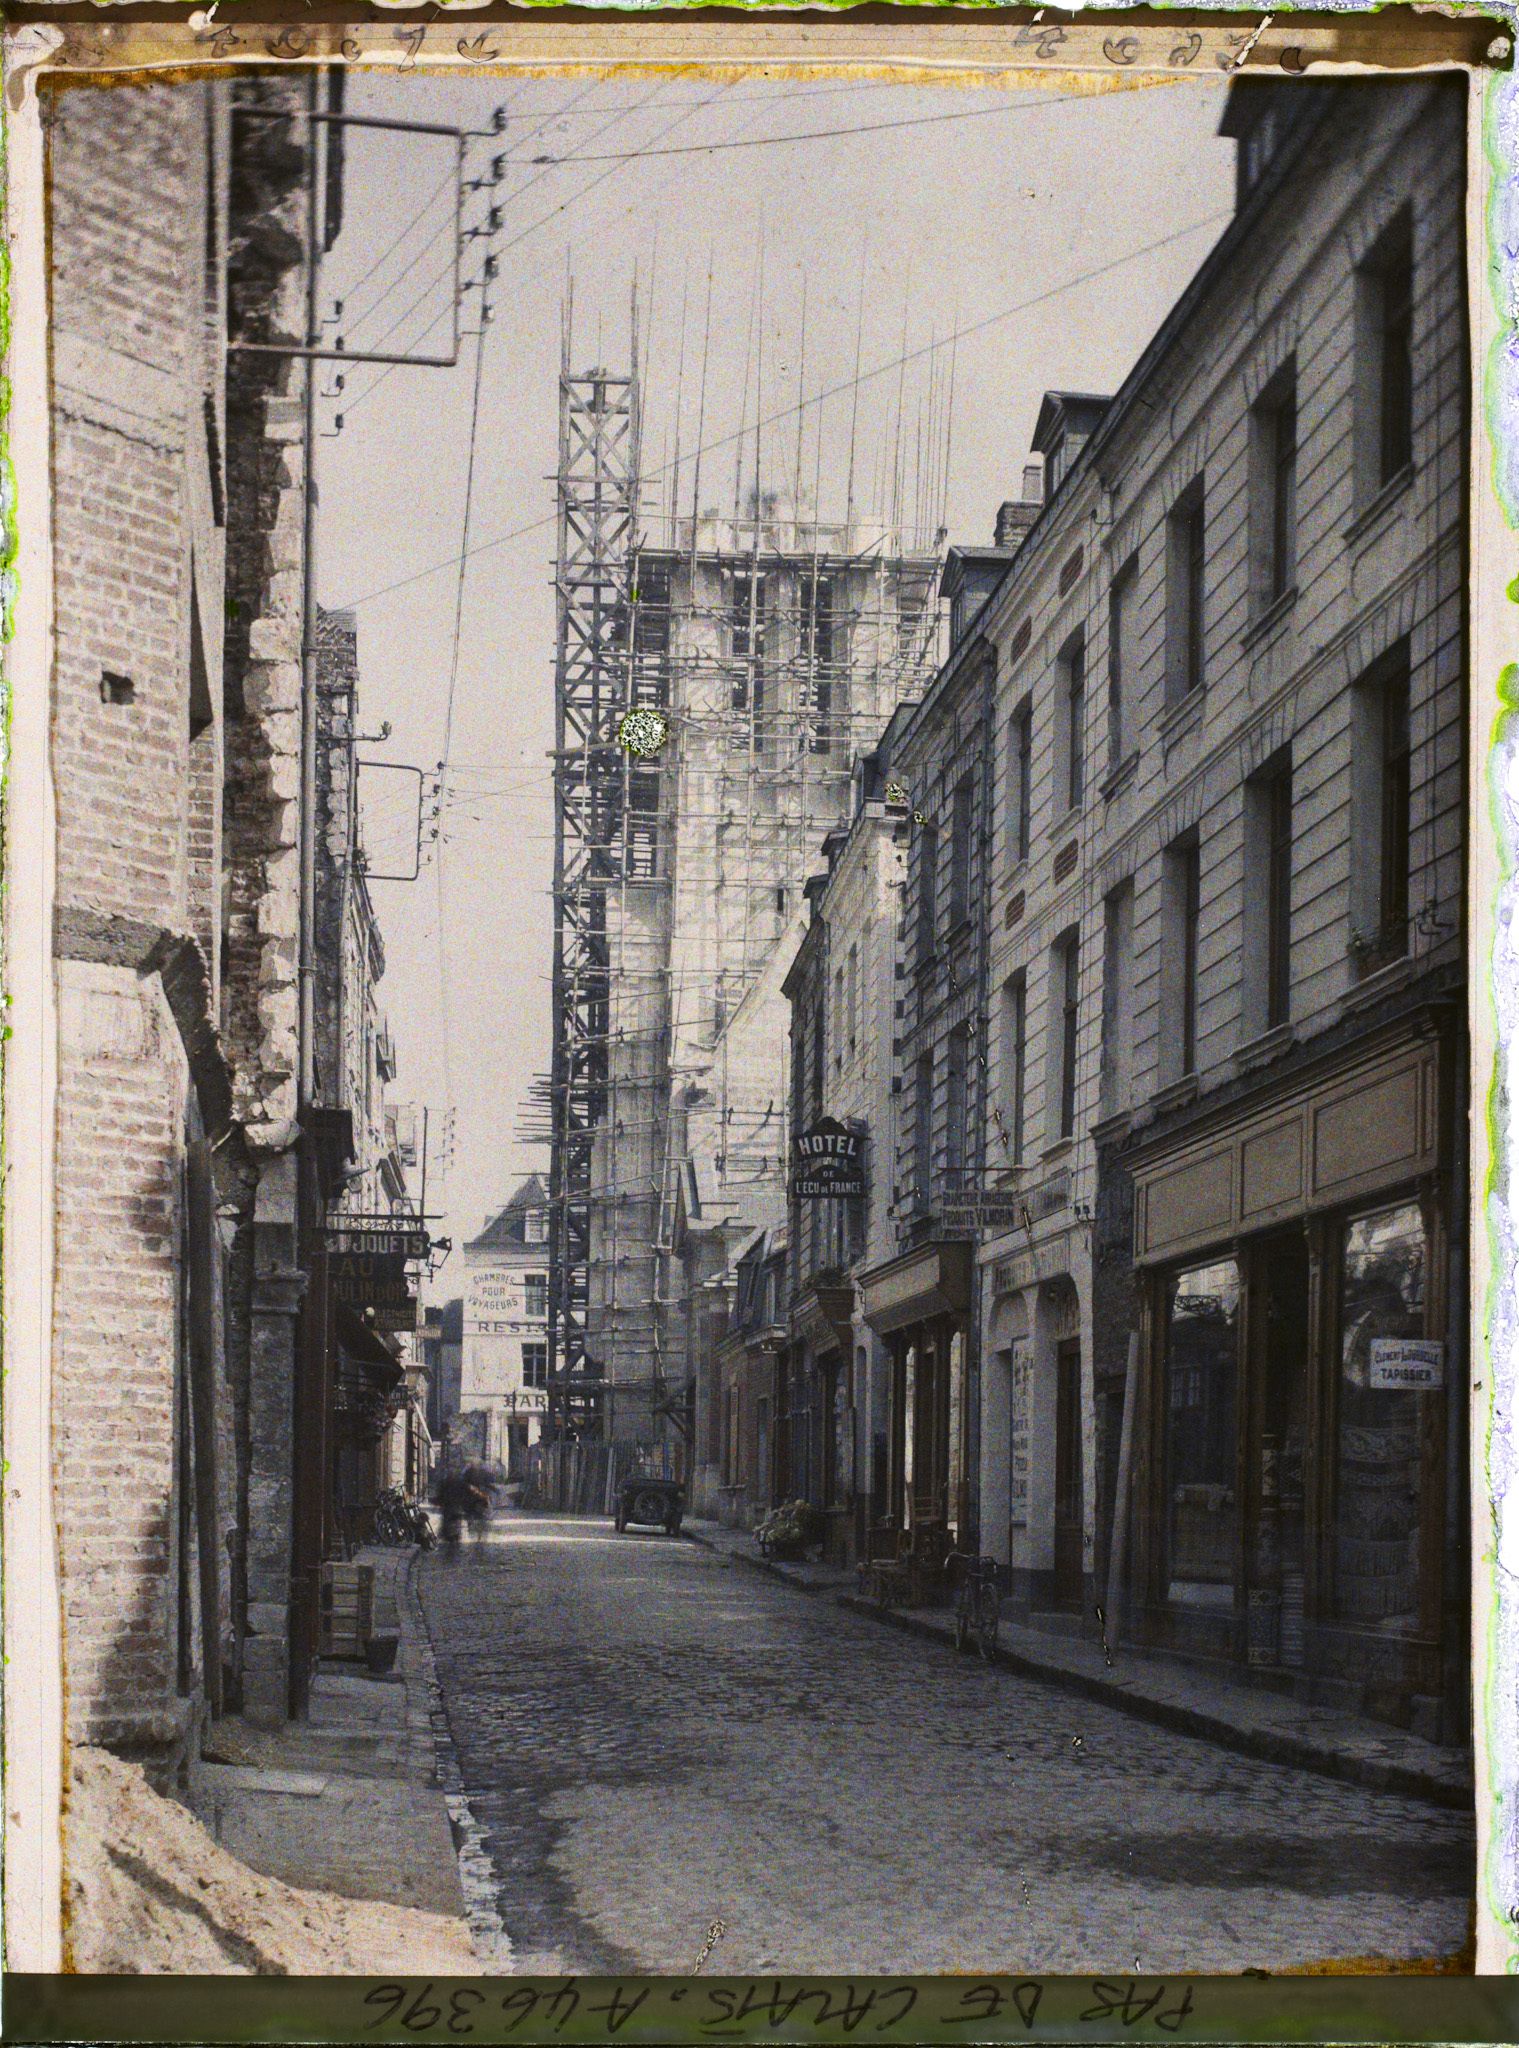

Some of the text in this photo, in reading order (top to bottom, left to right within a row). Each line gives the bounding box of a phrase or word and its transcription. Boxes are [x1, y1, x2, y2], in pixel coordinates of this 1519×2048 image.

[798, 1134, 857, 1156] HOTEL
[822, 1170, 835, 1178] DE
[830, 1181, 861, 1194] FRANCE
[352, 1233, 424, 1254] JOUETS
[473, 1273, 515, 1285] CHAMBRES
[482, 1287, 506, 1296] POUR
[468, 1295, 518, 1311] VOYAGEURS
[1380, 1368, 1433, 1381] TAPISSIER
[940, 1982, 1044, 2029] DE
[1078, 1982, 1194, 2033] PAS
